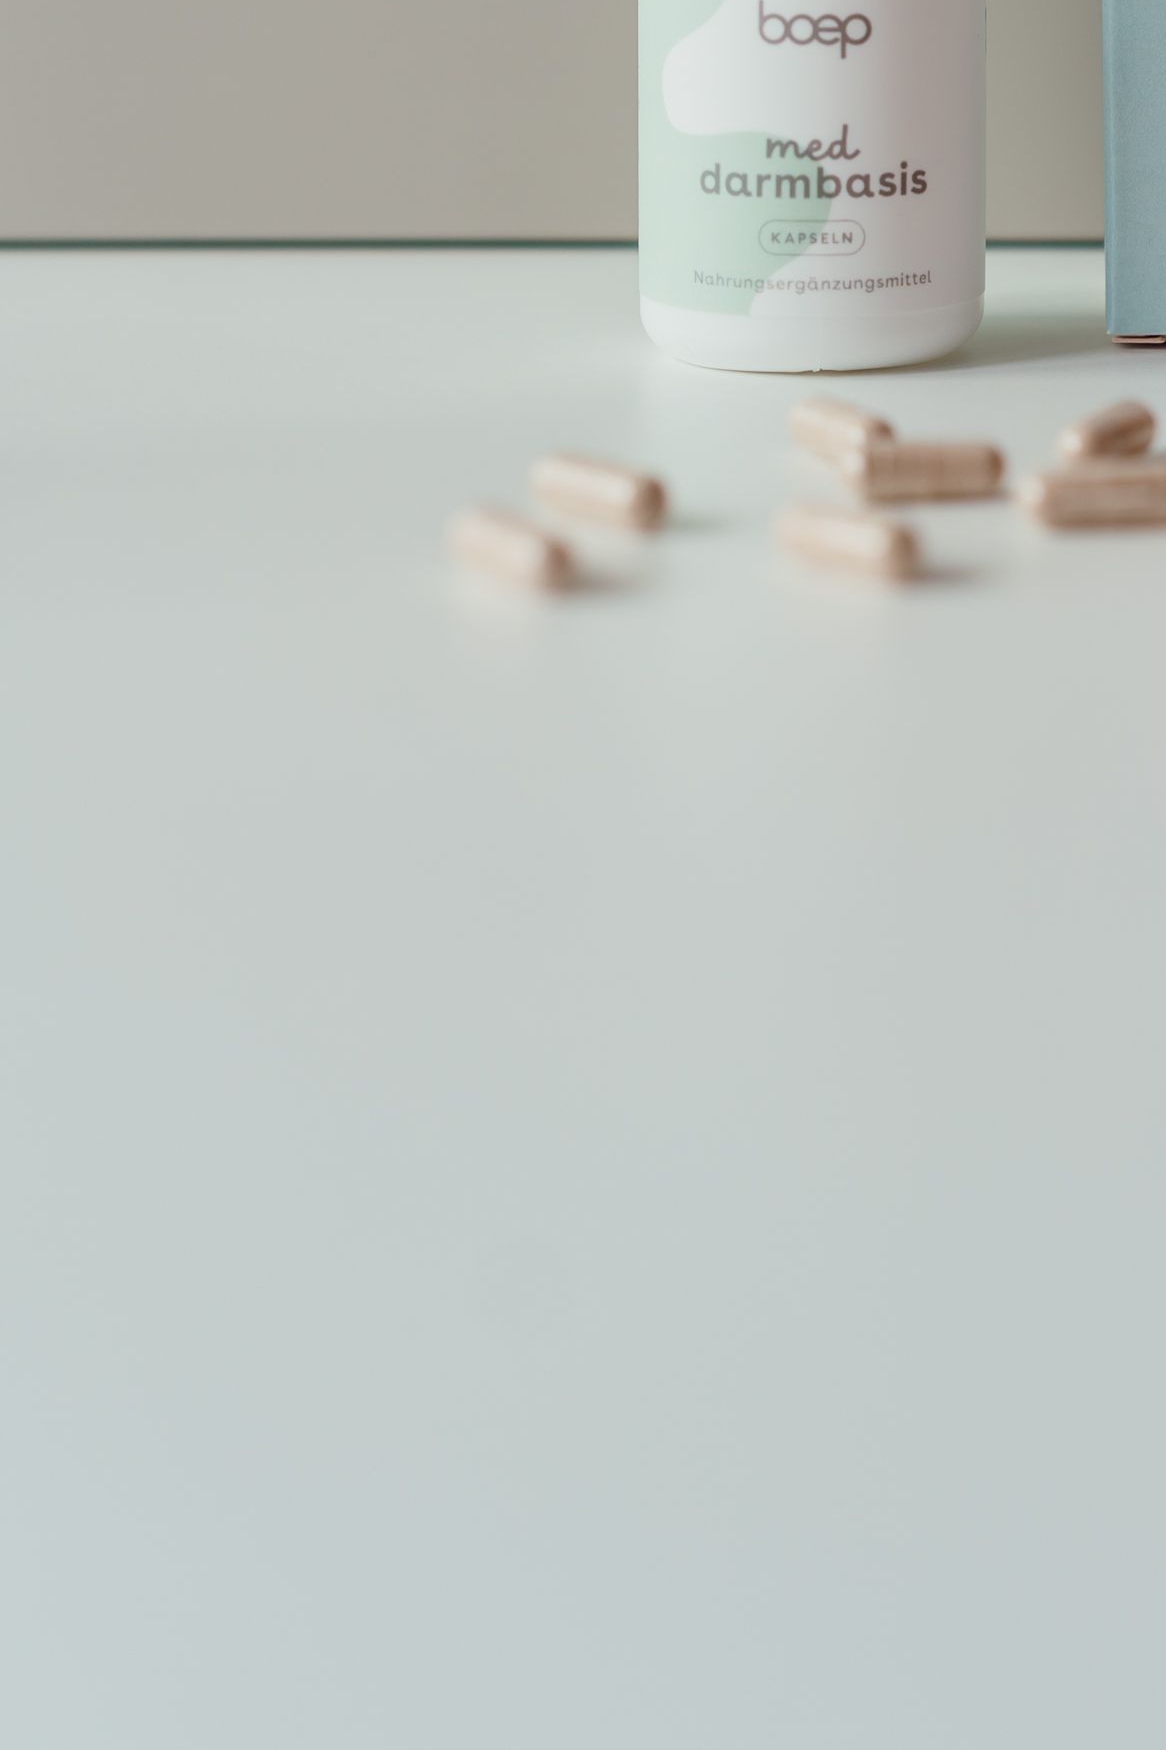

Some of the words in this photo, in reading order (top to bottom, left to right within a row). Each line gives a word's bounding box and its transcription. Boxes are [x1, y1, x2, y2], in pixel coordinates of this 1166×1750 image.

[765, 123, 861, 162] med
[699, 160, 929, 200] darmbasis
[770, 230, 855, 246] KAPSELN
[693, 270, 934, 295] Nahrungsergänzungsmittel
